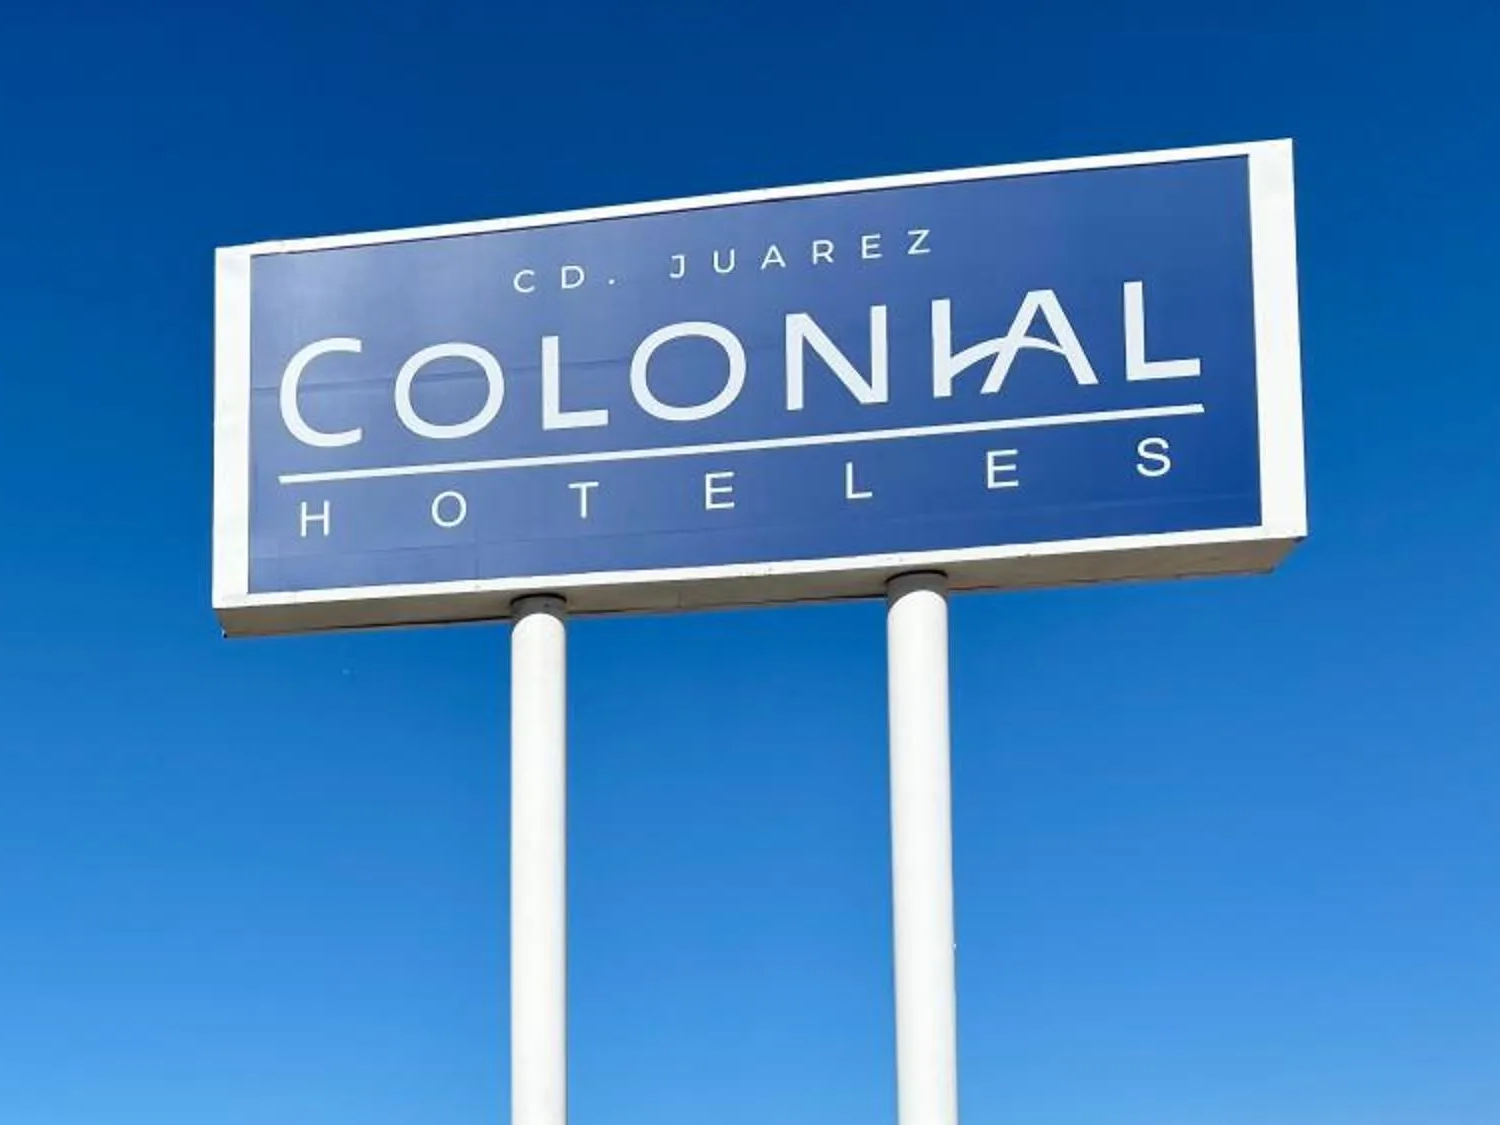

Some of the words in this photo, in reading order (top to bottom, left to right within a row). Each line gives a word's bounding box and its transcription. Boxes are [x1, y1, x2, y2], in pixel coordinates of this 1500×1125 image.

[513, 265, 617, 294] CD.
[670, 229, 930, 280] JUAREZ
[279, 281, 1201, 448] COLONIAL
[300, 437, 1171, 537] HOTELES
